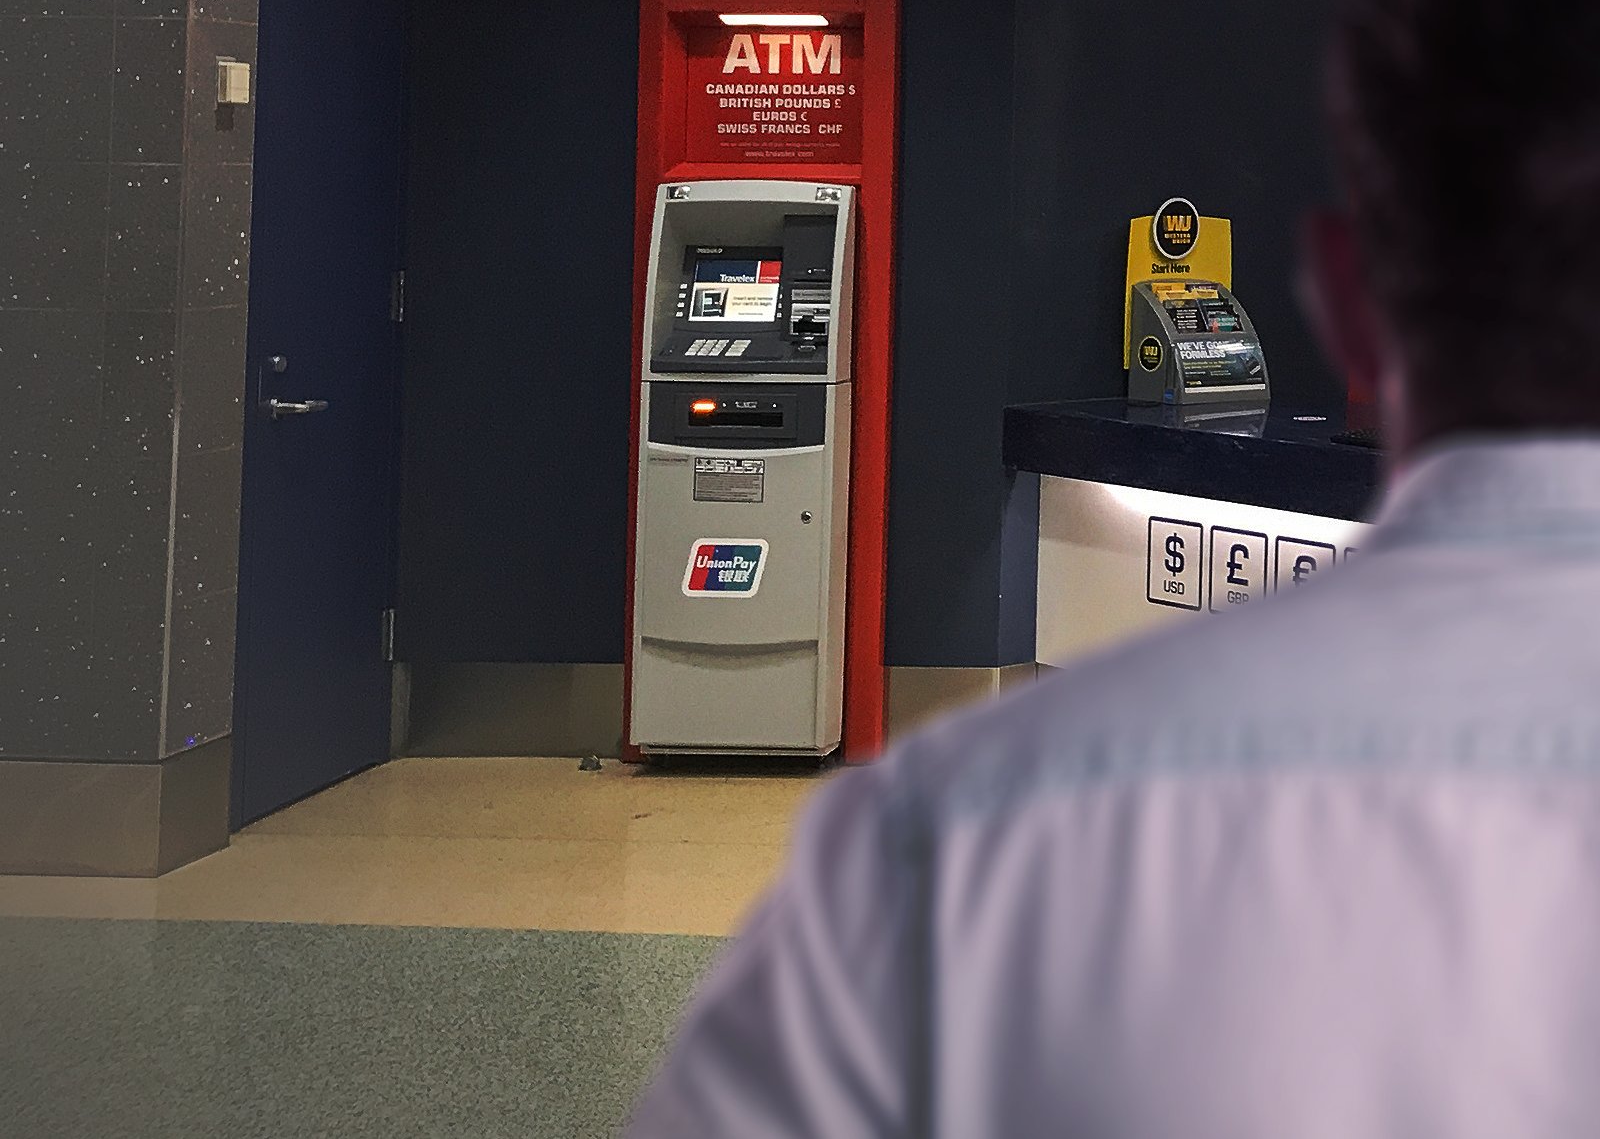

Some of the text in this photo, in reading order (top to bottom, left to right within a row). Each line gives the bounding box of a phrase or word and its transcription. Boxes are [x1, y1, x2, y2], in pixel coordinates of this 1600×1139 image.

[722, 33, 842, 74] ATM
[705, 83, 779, 95] CANADIAN
[782, 83, 845, 96] DOLLARS
[718, 97, 772, 109] BRITISH
[774, 97, 831, 109] POUNDS
[752, 111, 797, 122] EUROS
[717, 123, 843, 135] SWISS FRANCS CHF
[1151, 262, 1191, 274] Start Here
[719, 273, 756, 283] Travelex
[1177, 341, 1206, 351] WE'VE
[1164, 532, 1186, 577] $
[696, 555, 757, 574] UnionPay
[1226, 543, 1250, 587] £
[1163, 579, 1185, 595] USD
[1227, 590, 1249, 605] GBP
